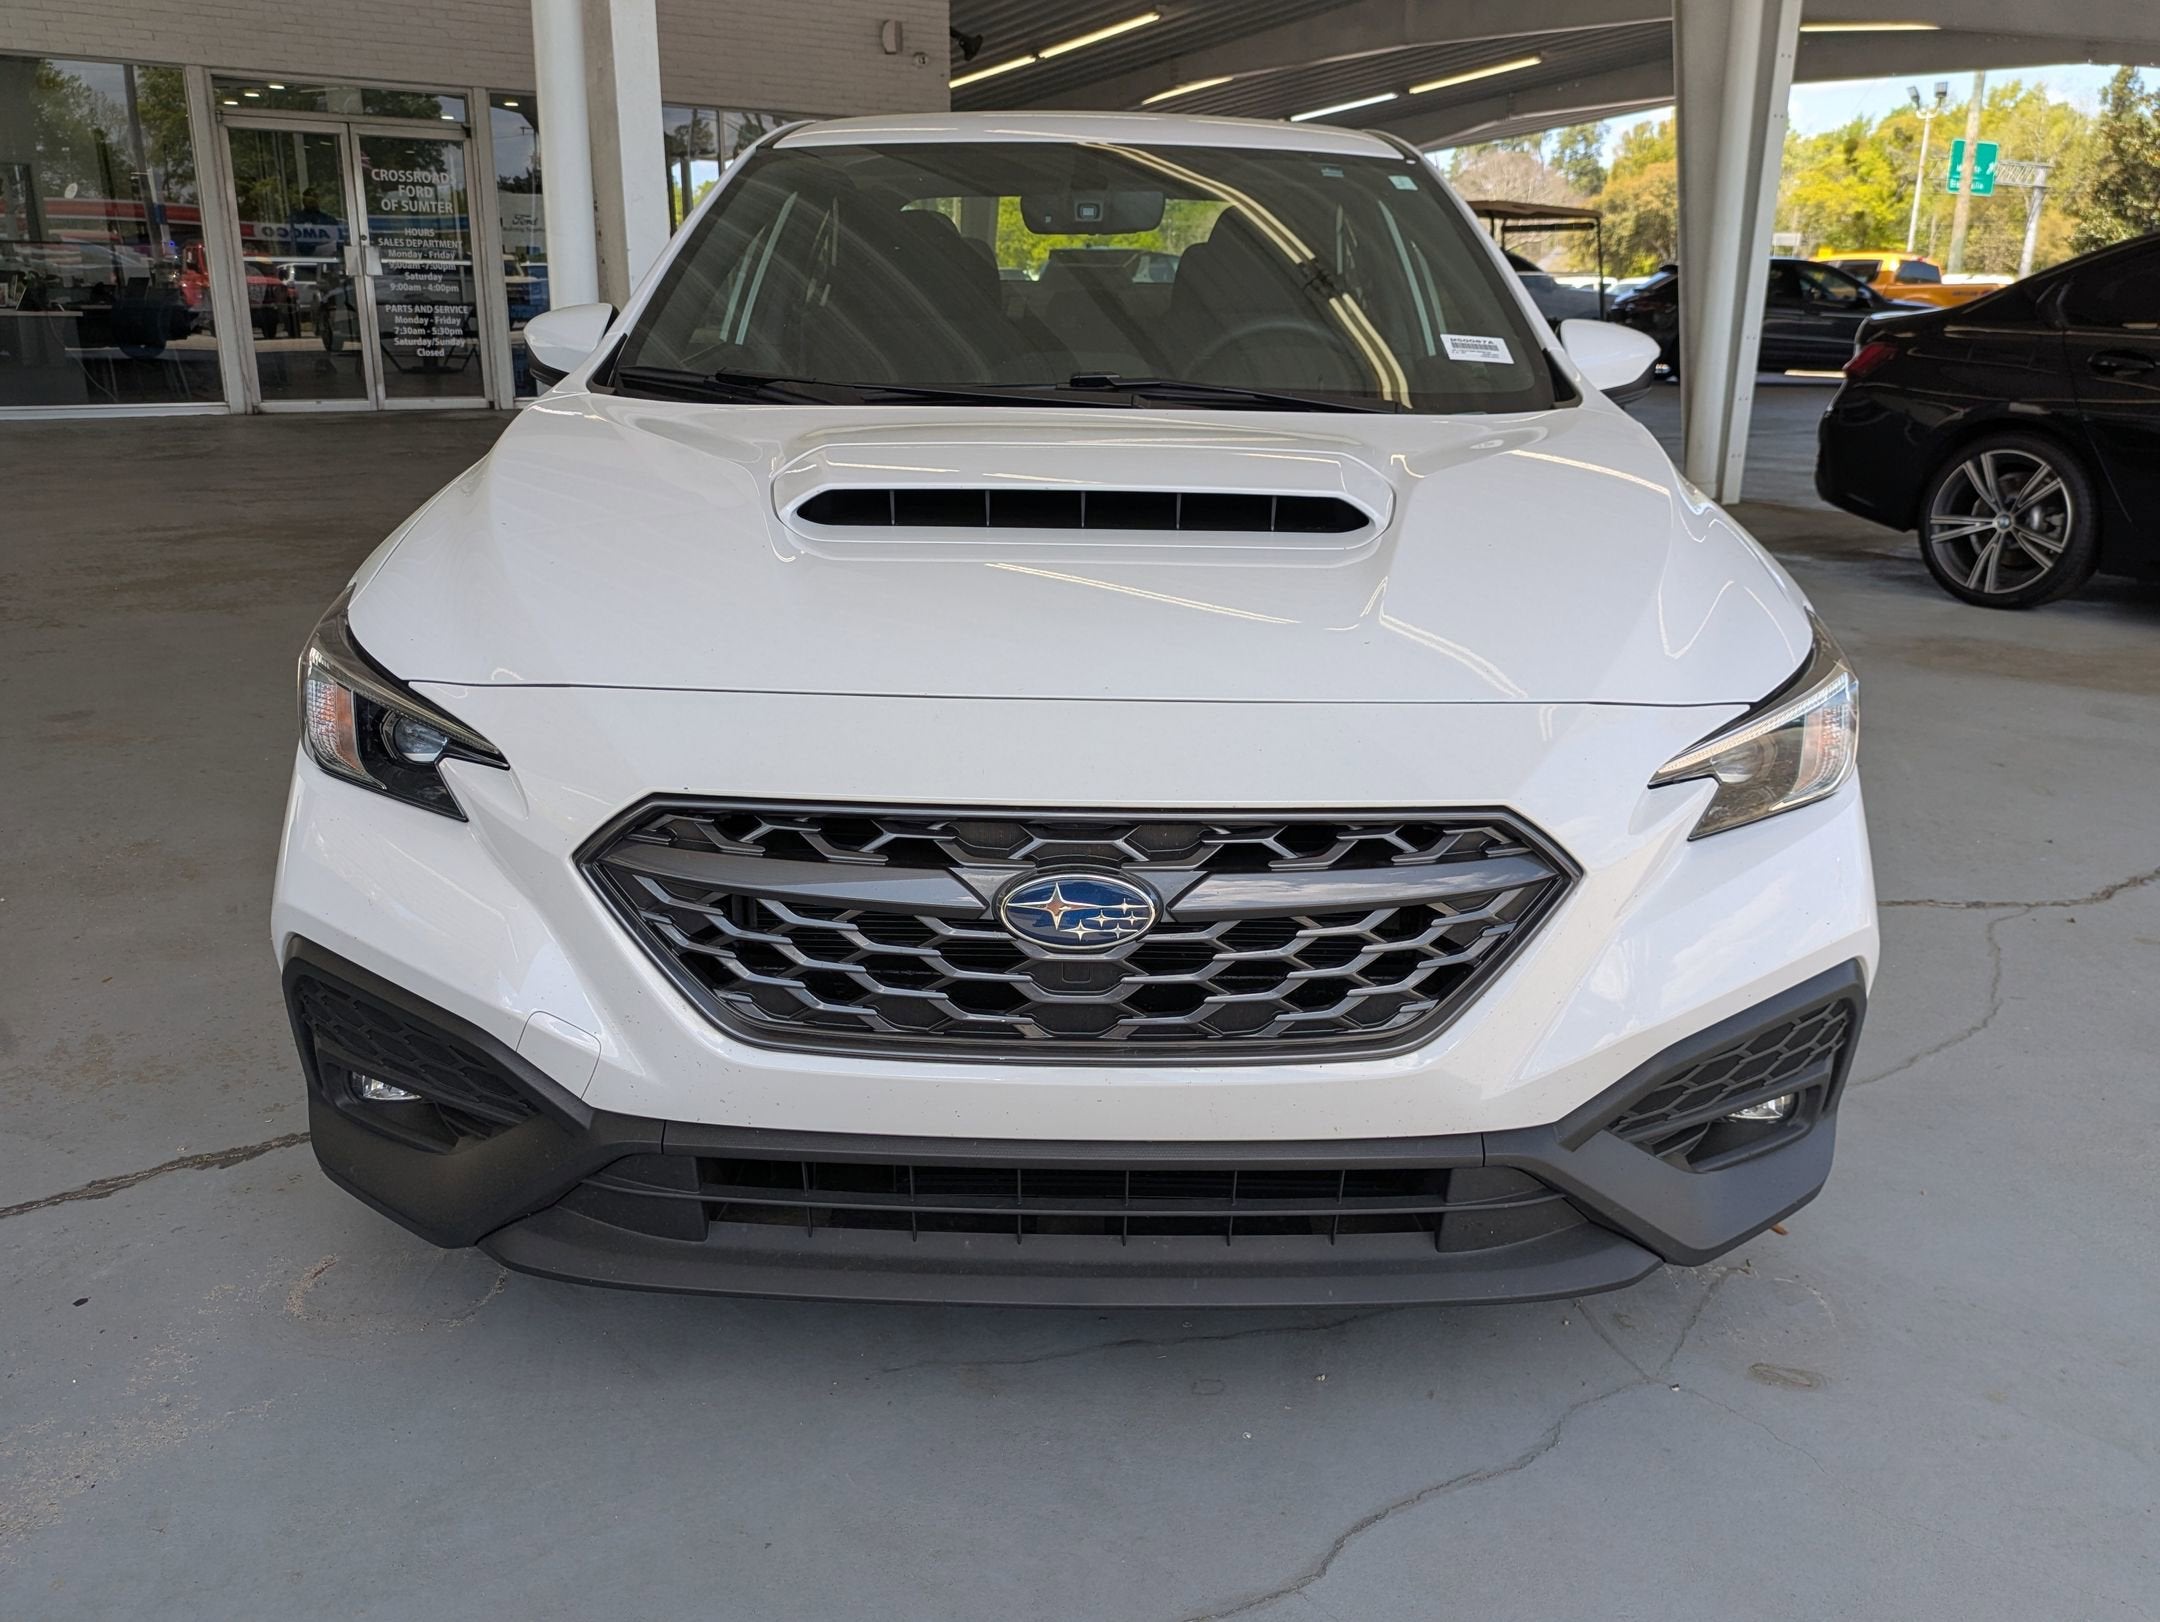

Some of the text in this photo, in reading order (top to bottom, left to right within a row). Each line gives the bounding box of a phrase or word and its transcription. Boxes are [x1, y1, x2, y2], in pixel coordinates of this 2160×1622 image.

[398, 185, 433, 198] FORD
[381, 199, 453, 214] OF SUMTER
[404, 227, 435, 237] HOURS
[378, 238, 462, 249] SALES DEPARTMENT
[388, 249, 423, 260] Monday
[429, 250, 456, 261] Friday
[404, 272, 443, 283] Saturday
[390, 283, 422, 292] 9:00am
[428, 284, 459, 294] 4:00pm
[385, 304, 469, 314] PARTS AND SERVICE
[394, 315, 429, 326] Monday
[434, 316, 461, 327] Friday
[393, 327, 426, 335] 7:30am
[431, 327, 463, 337] 5:30pm
[394, 337, 465, 348] Saturday/Sunday
[416, 348, 445, 357] Closed
